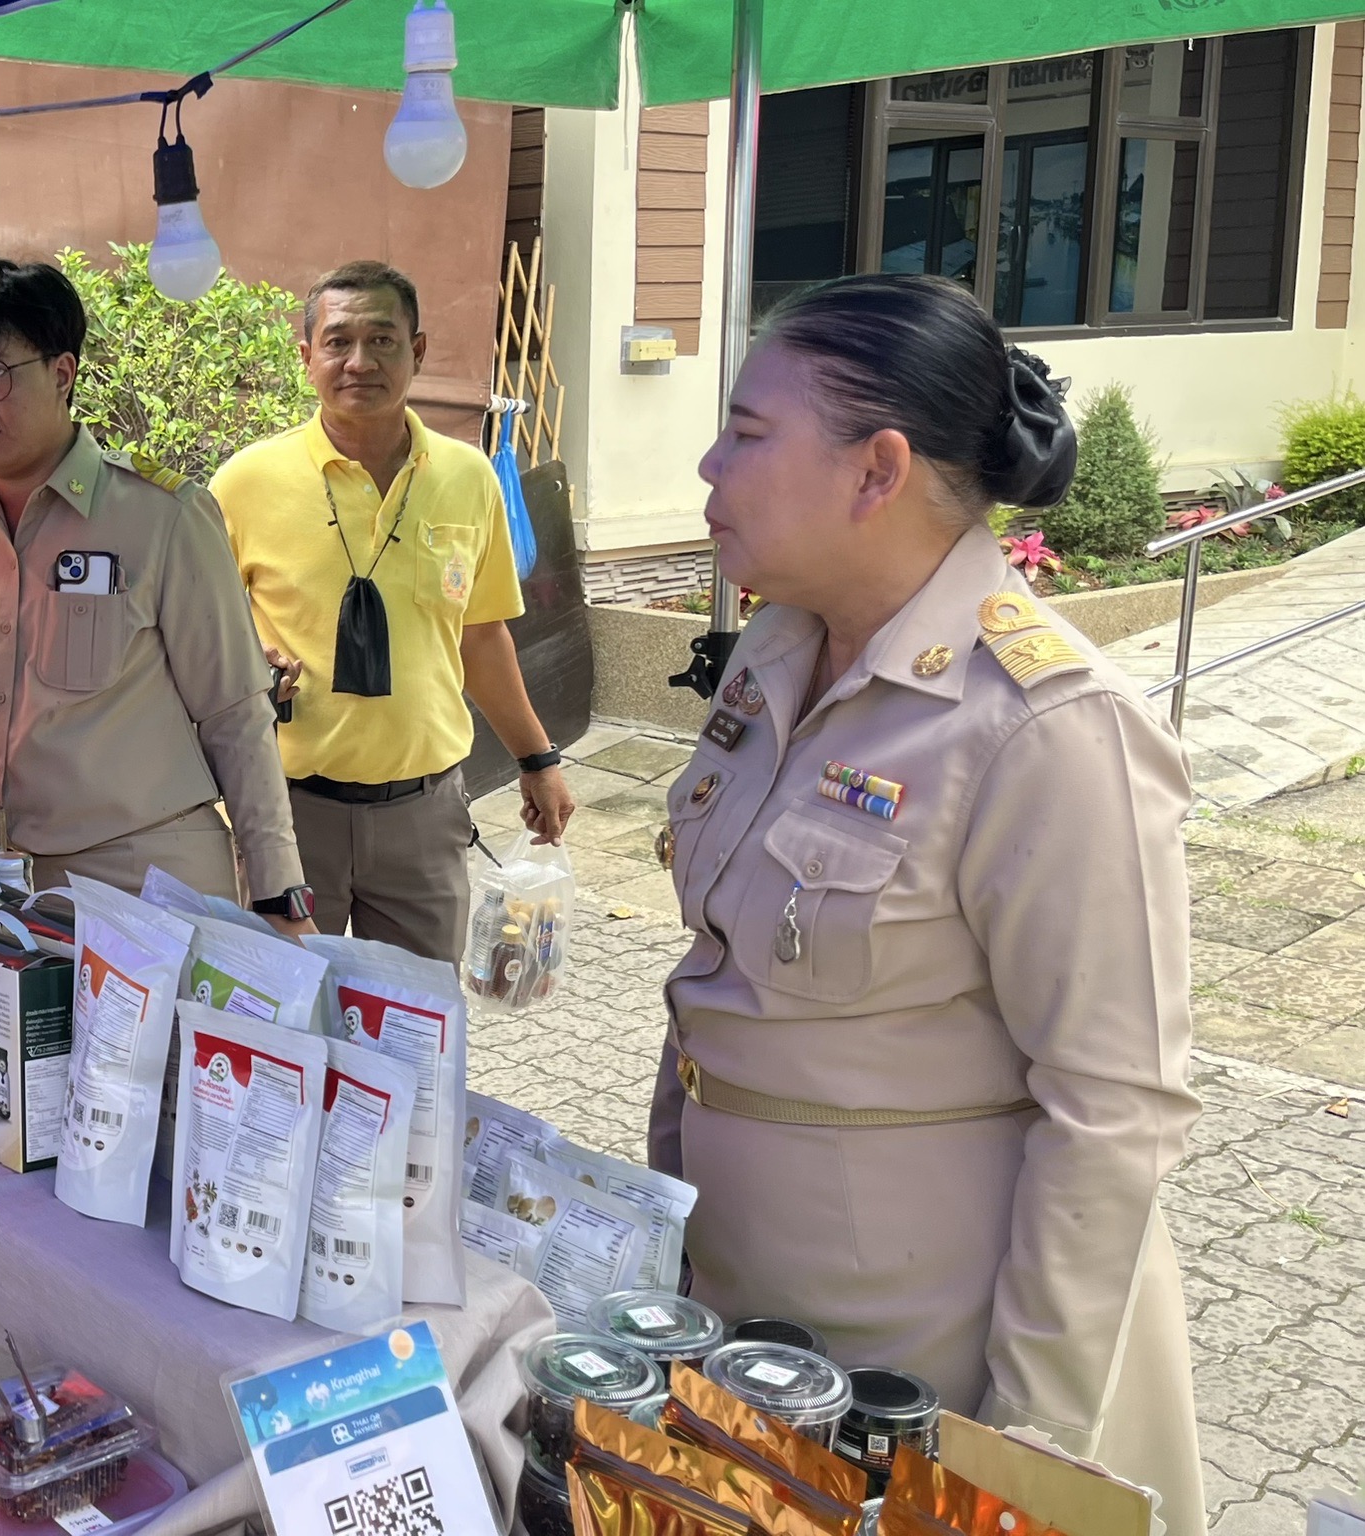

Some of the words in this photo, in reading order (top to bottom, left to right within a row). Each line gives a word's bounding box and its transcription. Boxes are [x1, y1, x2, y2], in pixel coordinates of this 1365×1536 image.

[330, 1363, 381, 1391] Krungthai
[351, 1417, 369, 1429] THAI
[369, 1412, 381, 1425] QR
[353, 1421, 383, 1437] PAYMENT
